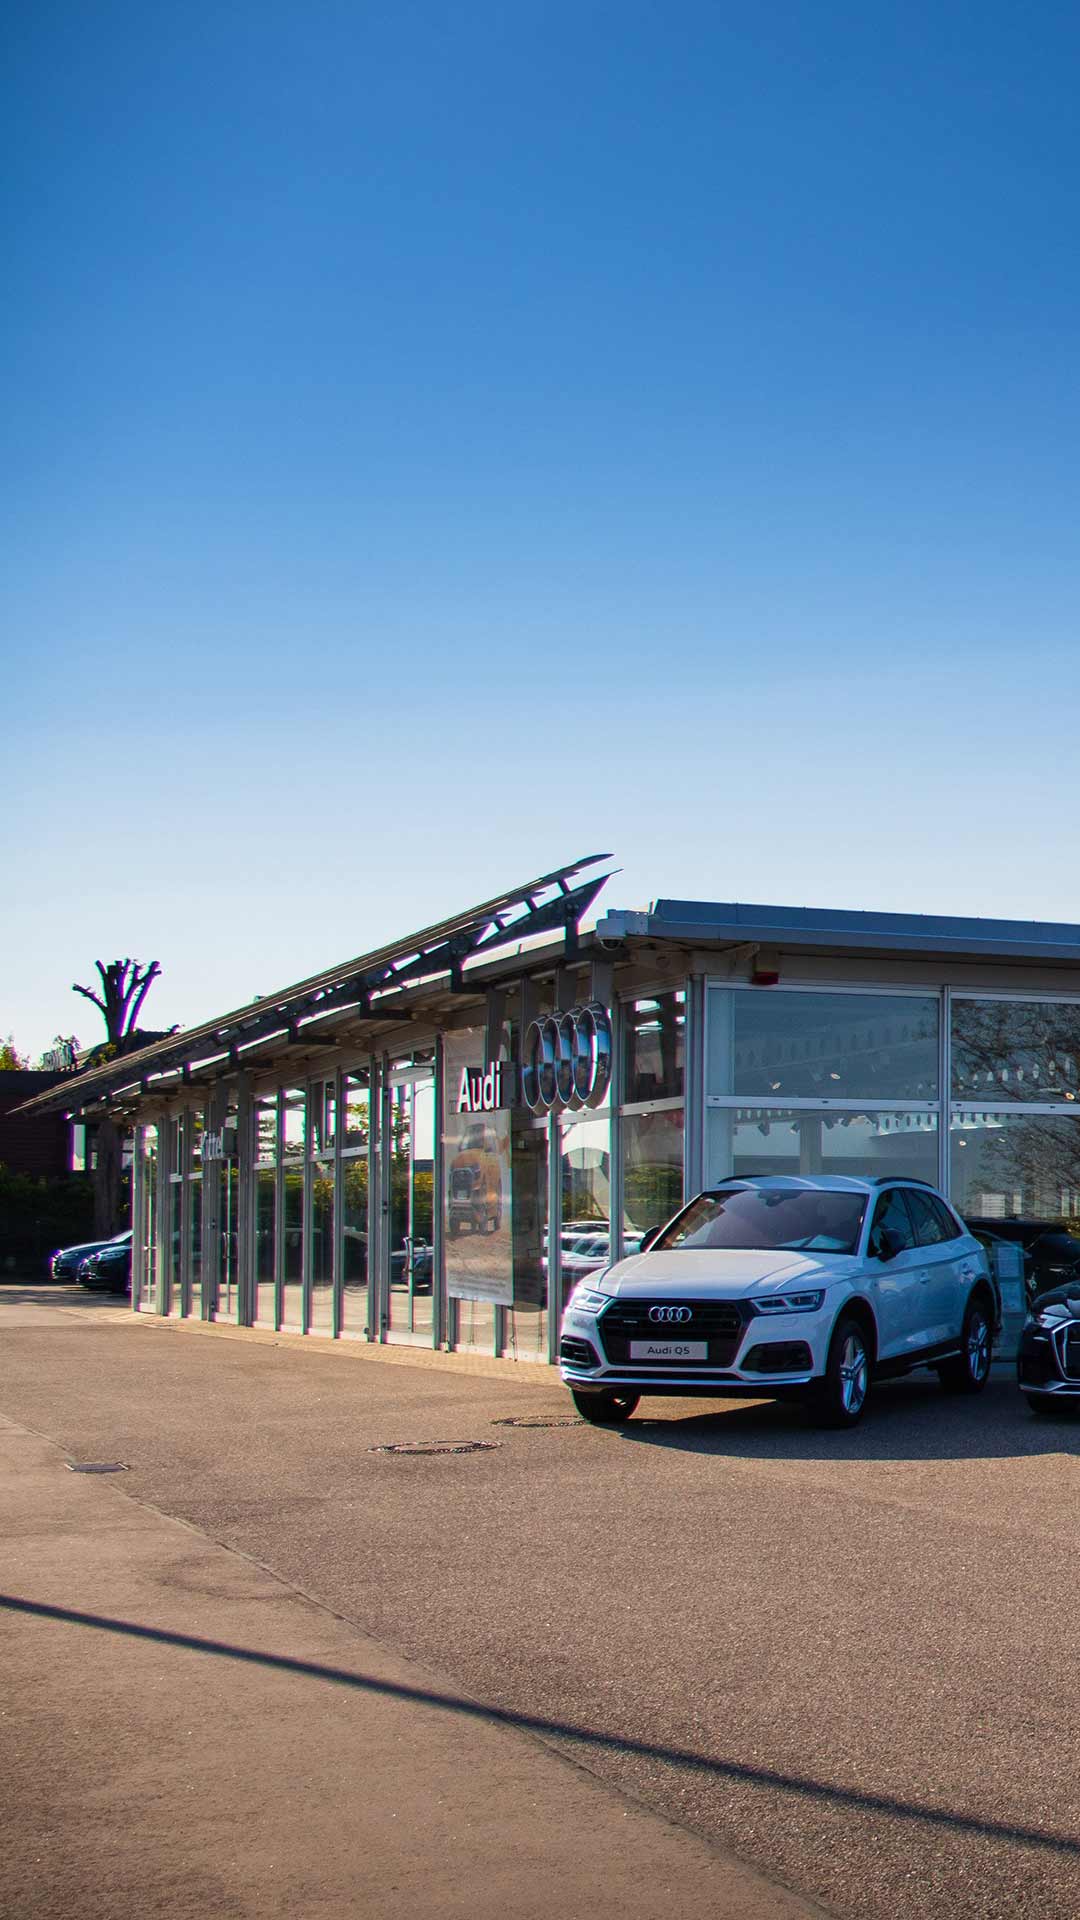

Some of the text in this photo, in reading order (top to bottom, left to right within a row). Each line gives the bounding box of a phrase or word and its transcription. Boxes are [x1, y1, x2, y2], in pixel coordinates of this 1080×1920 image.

[457, 1061, 500, 1112] Audi
[647, 1346, 690, 1355] Audi Q5
